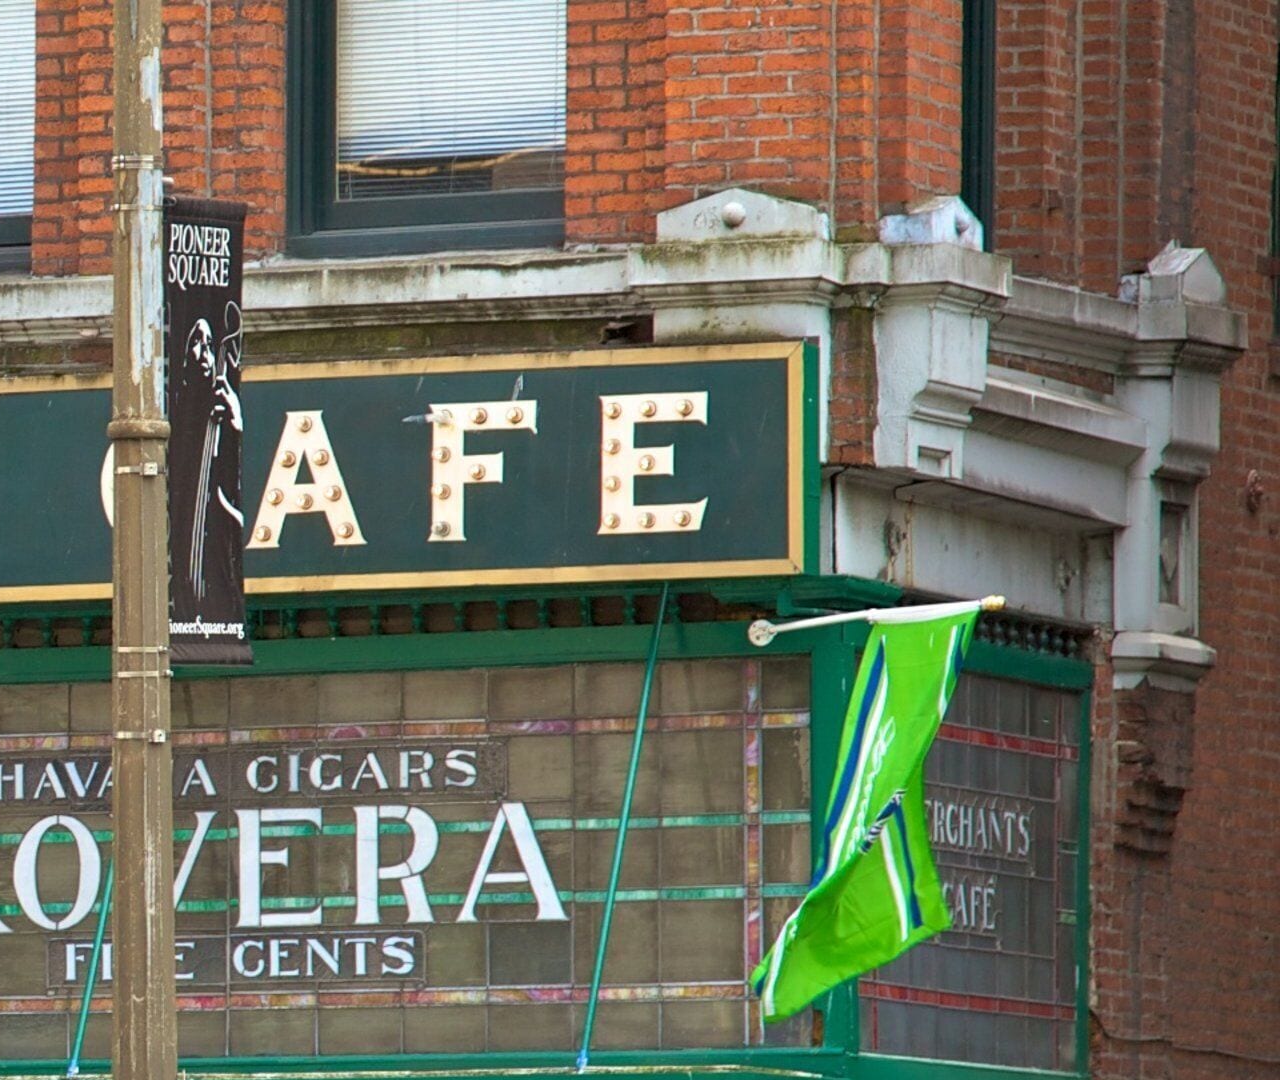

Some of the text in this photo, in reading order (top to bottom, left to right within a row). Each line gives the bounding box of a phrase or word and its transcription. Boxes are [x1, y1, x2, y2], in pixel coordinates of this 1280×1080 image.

[169, 224, 231, 257] PIONEER
[168, 254, 231, 291] SQUARE
[101, 391, 710, 549] AFE
[169, 615, 245, 640] ioneerSquare.org
[246, 750, 478, 793] CIGARS
[66, 934, 417, 981] FIE CENTS
